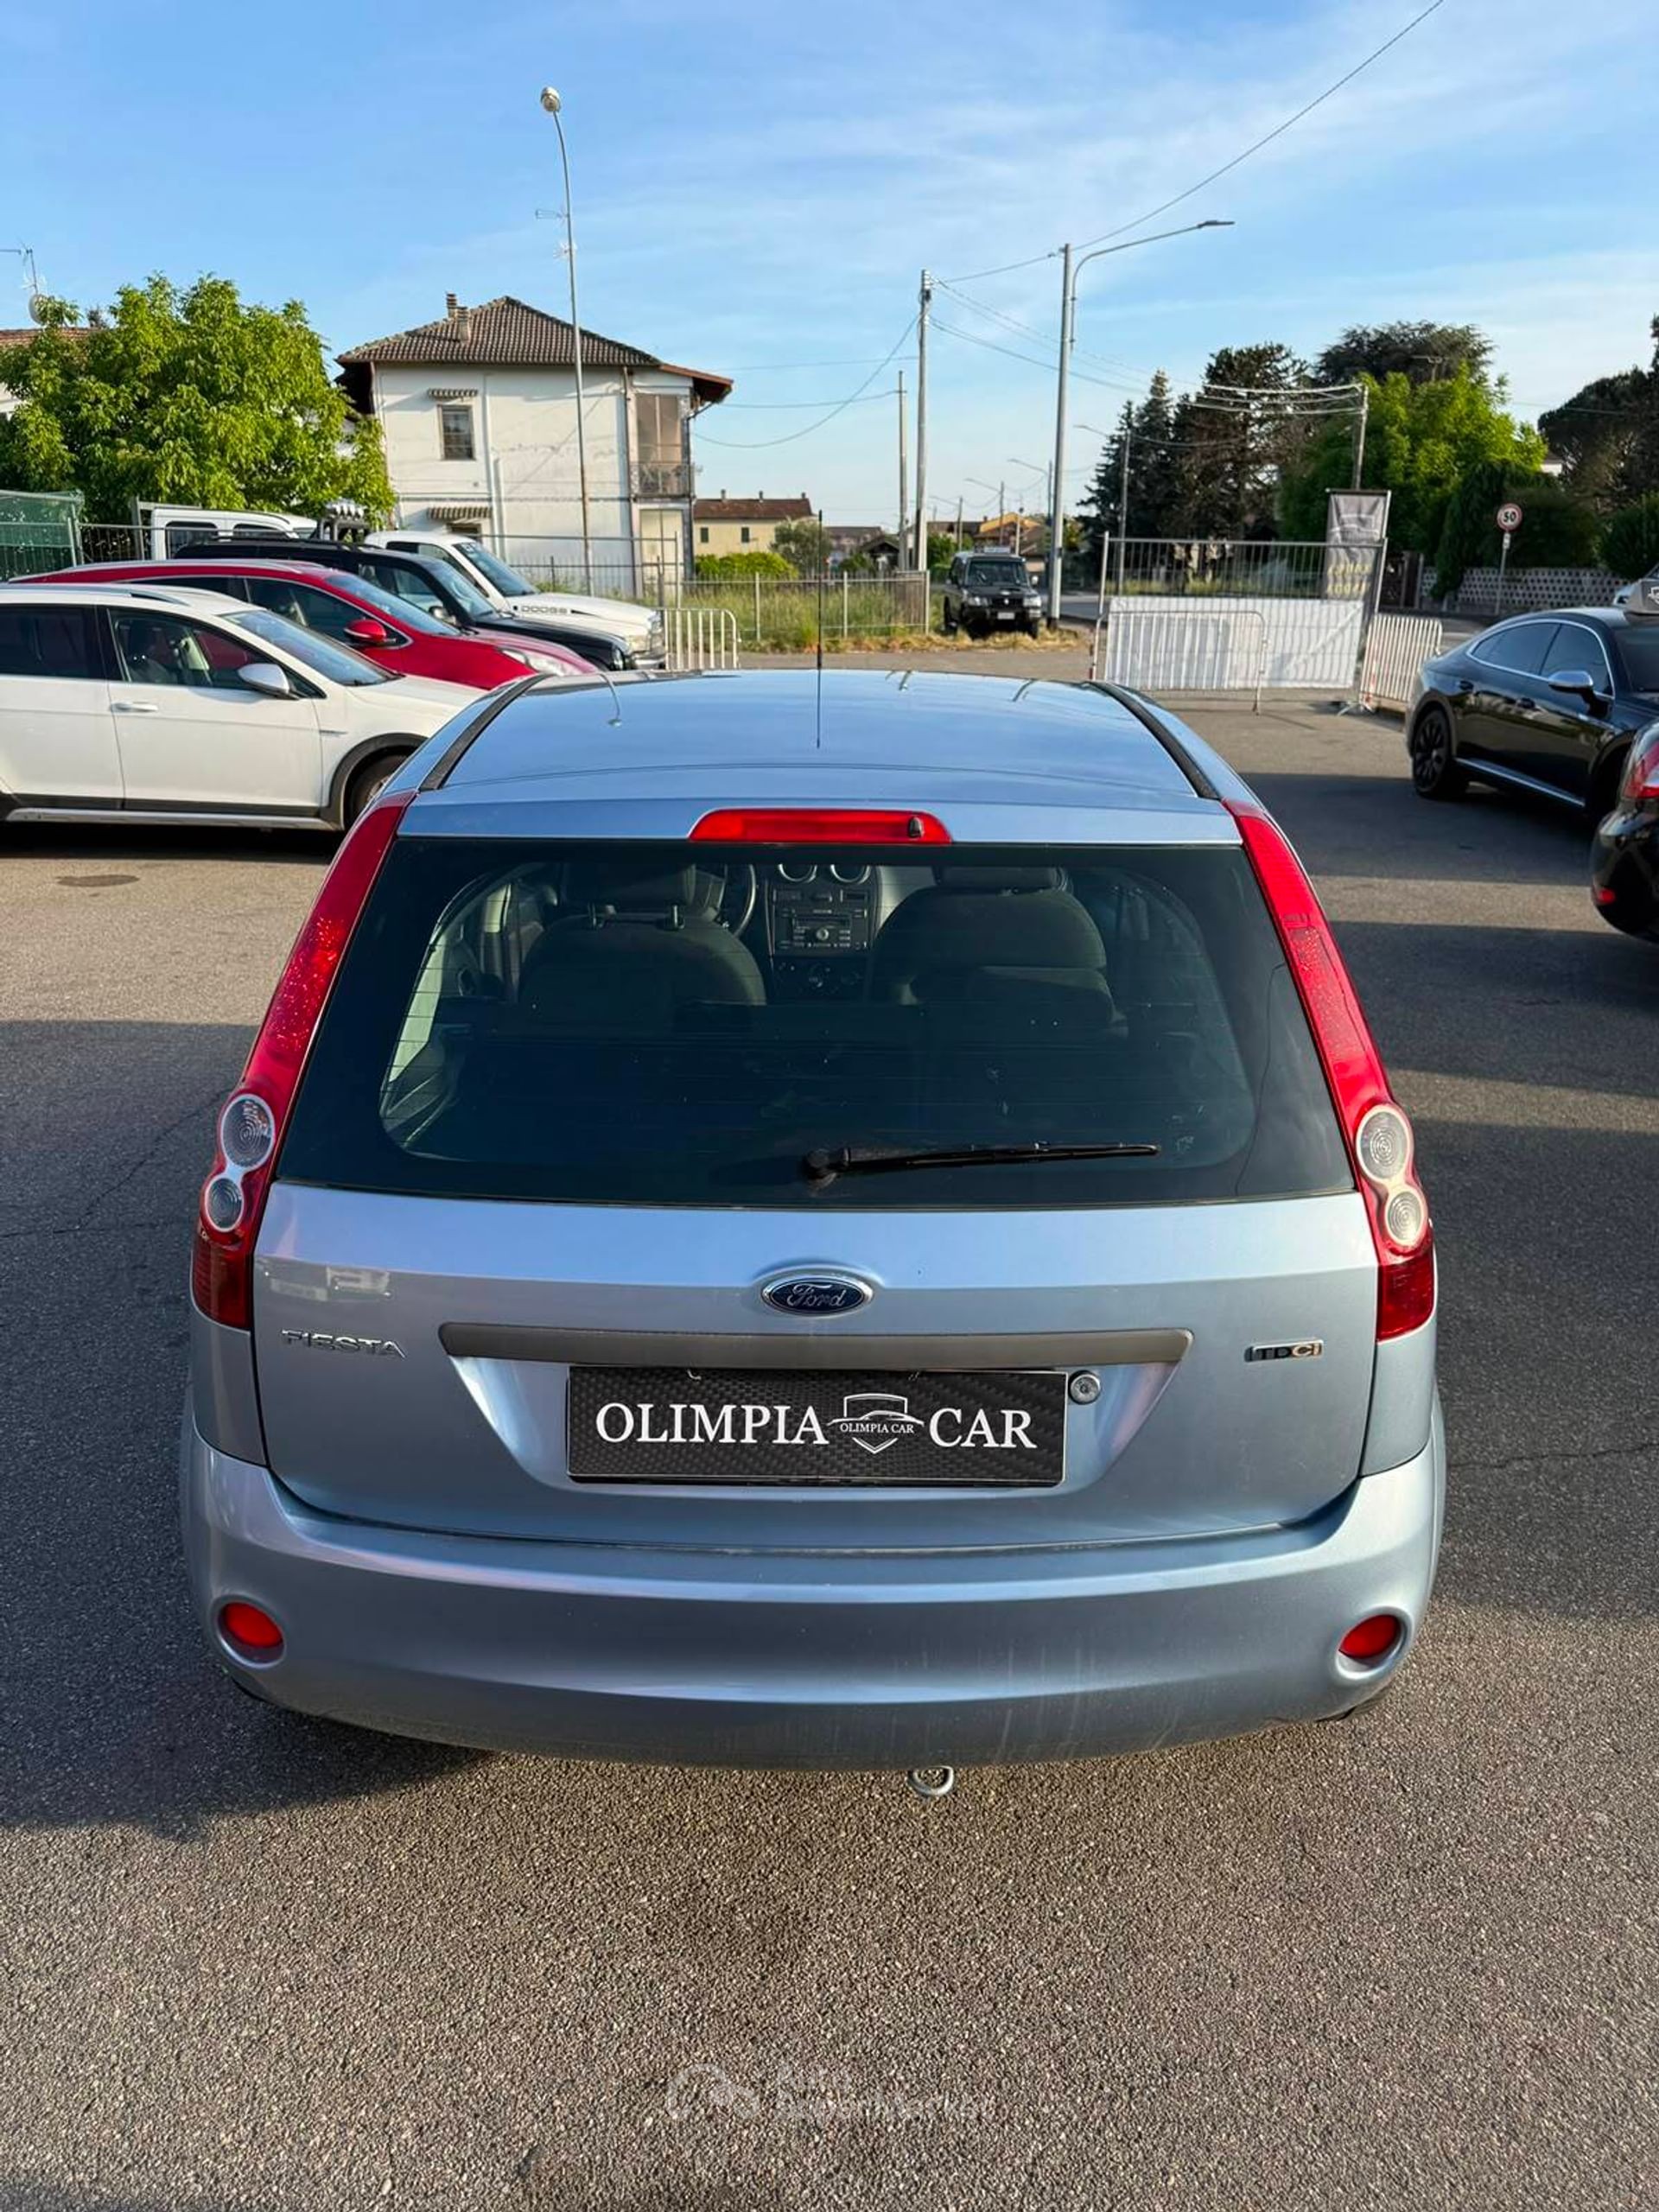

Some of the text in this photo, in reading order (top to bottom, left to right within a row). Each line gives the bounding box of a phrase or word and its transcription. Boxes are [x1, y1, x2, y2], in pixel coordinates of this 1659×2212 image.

[1503, 511, 1516, 523] 50
[521, 605, 568, 614] DODGE
[786, 1282, 848, 1307] Ford
[281, 1329, 407, 1359] FIESTA
[595, 1402, 1038, 1449] OLIMPIA CAR
[840, 1422, 914, 1434] OLIMPIA CAR
